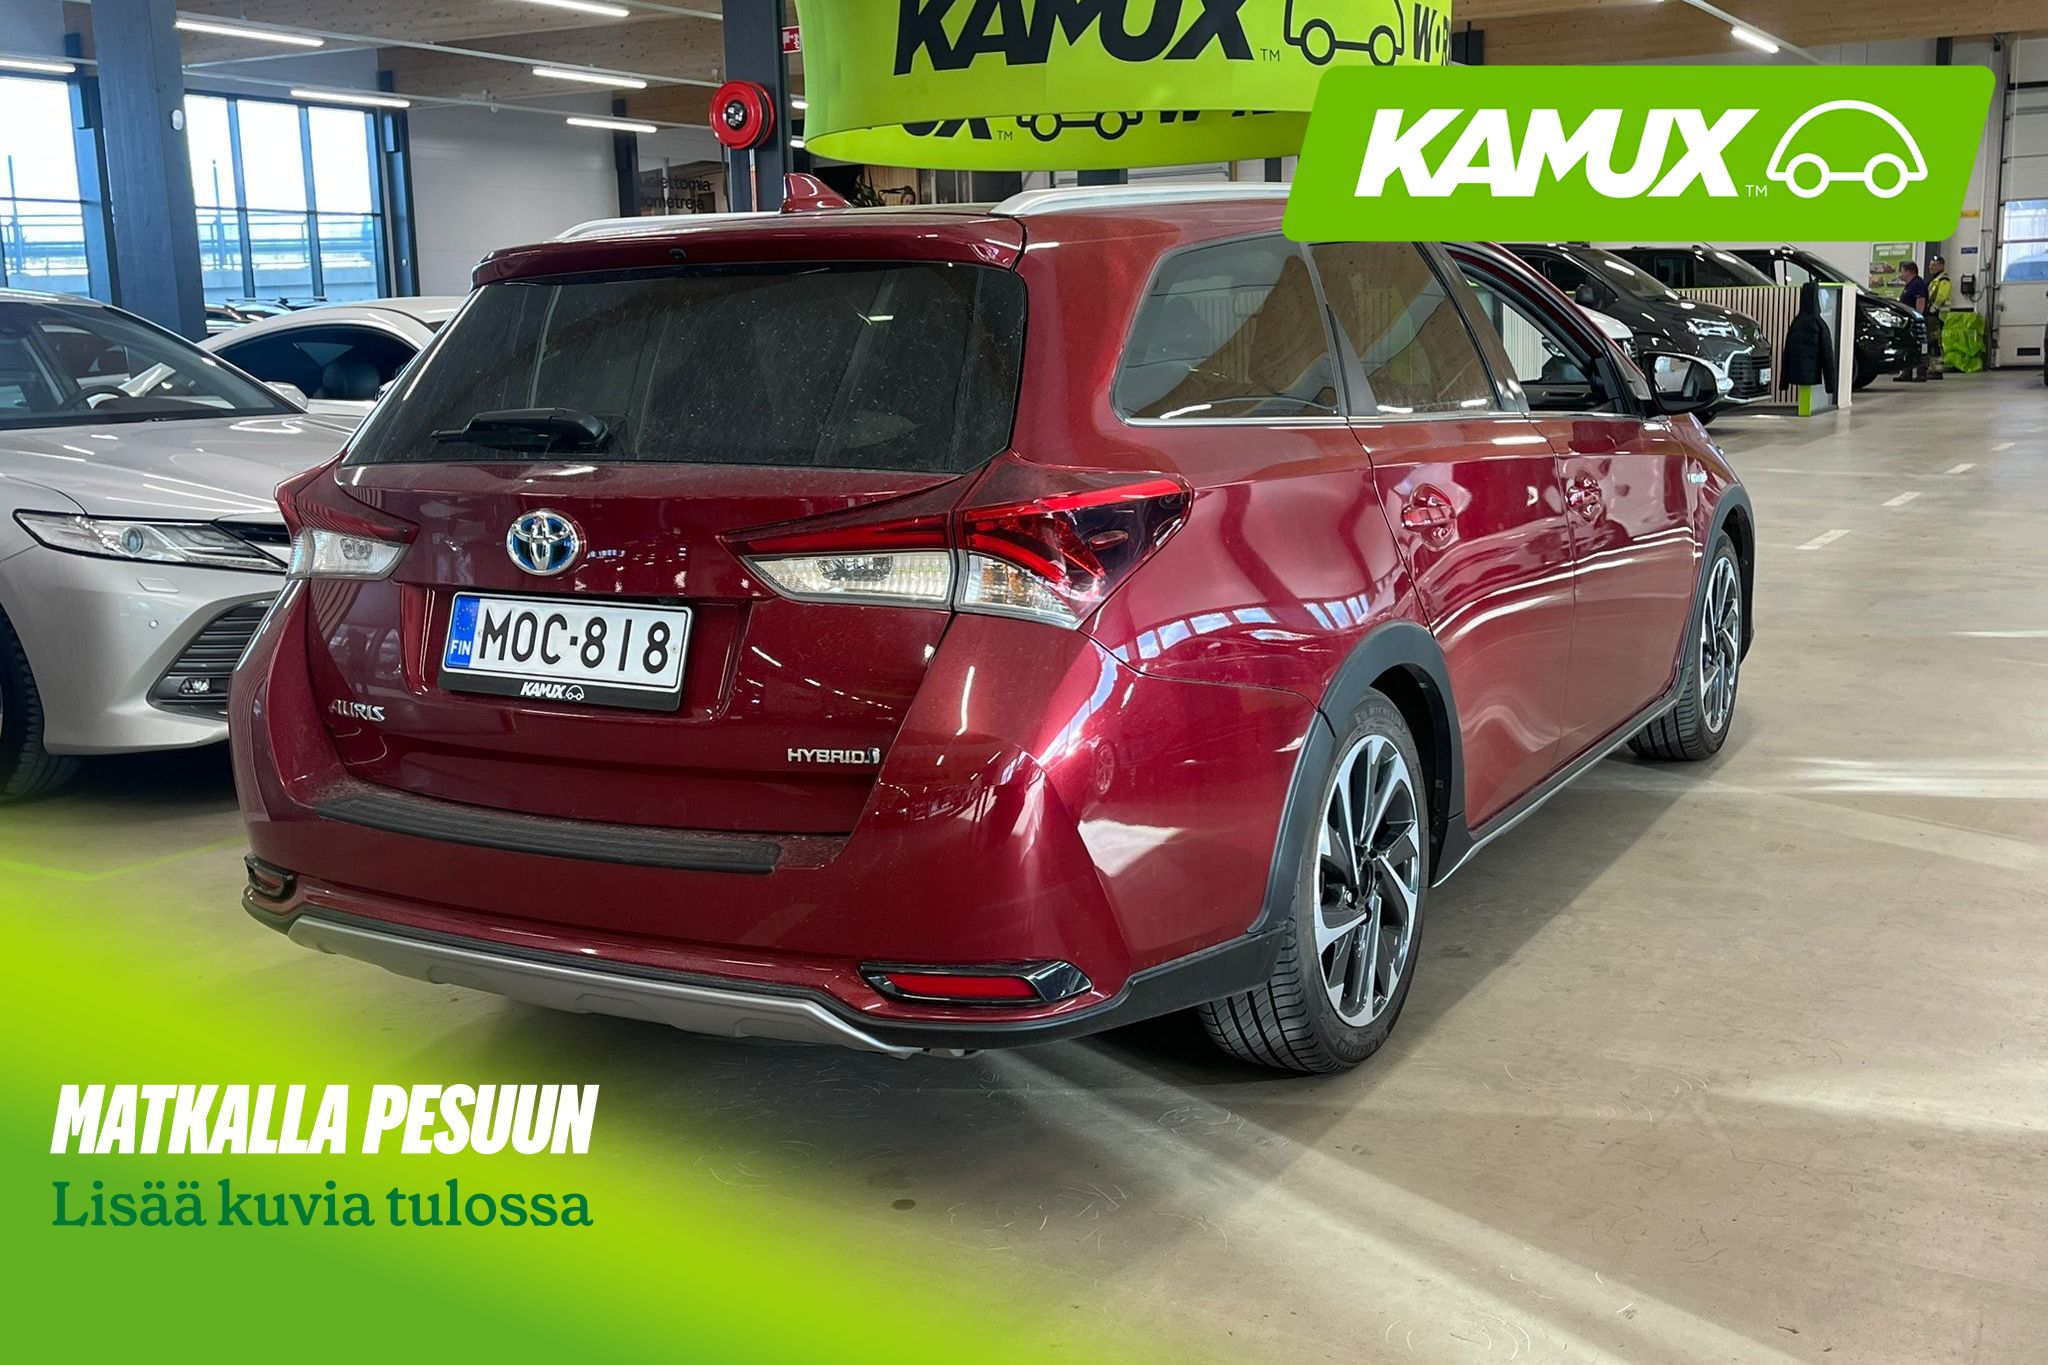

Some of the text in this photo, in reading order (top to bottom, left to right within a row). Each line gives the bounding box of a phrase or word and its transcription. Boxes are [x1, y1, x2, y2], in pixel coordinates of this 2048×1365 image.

[893, 0, 1254, 76] KAMUX
[450, 608, 671, 674] FIN MOC-818
[520, 681, 567, 699] KAMUX
[329, 699, 385, 722] AURIS
[787, 747, 865, 764] HYBRID
